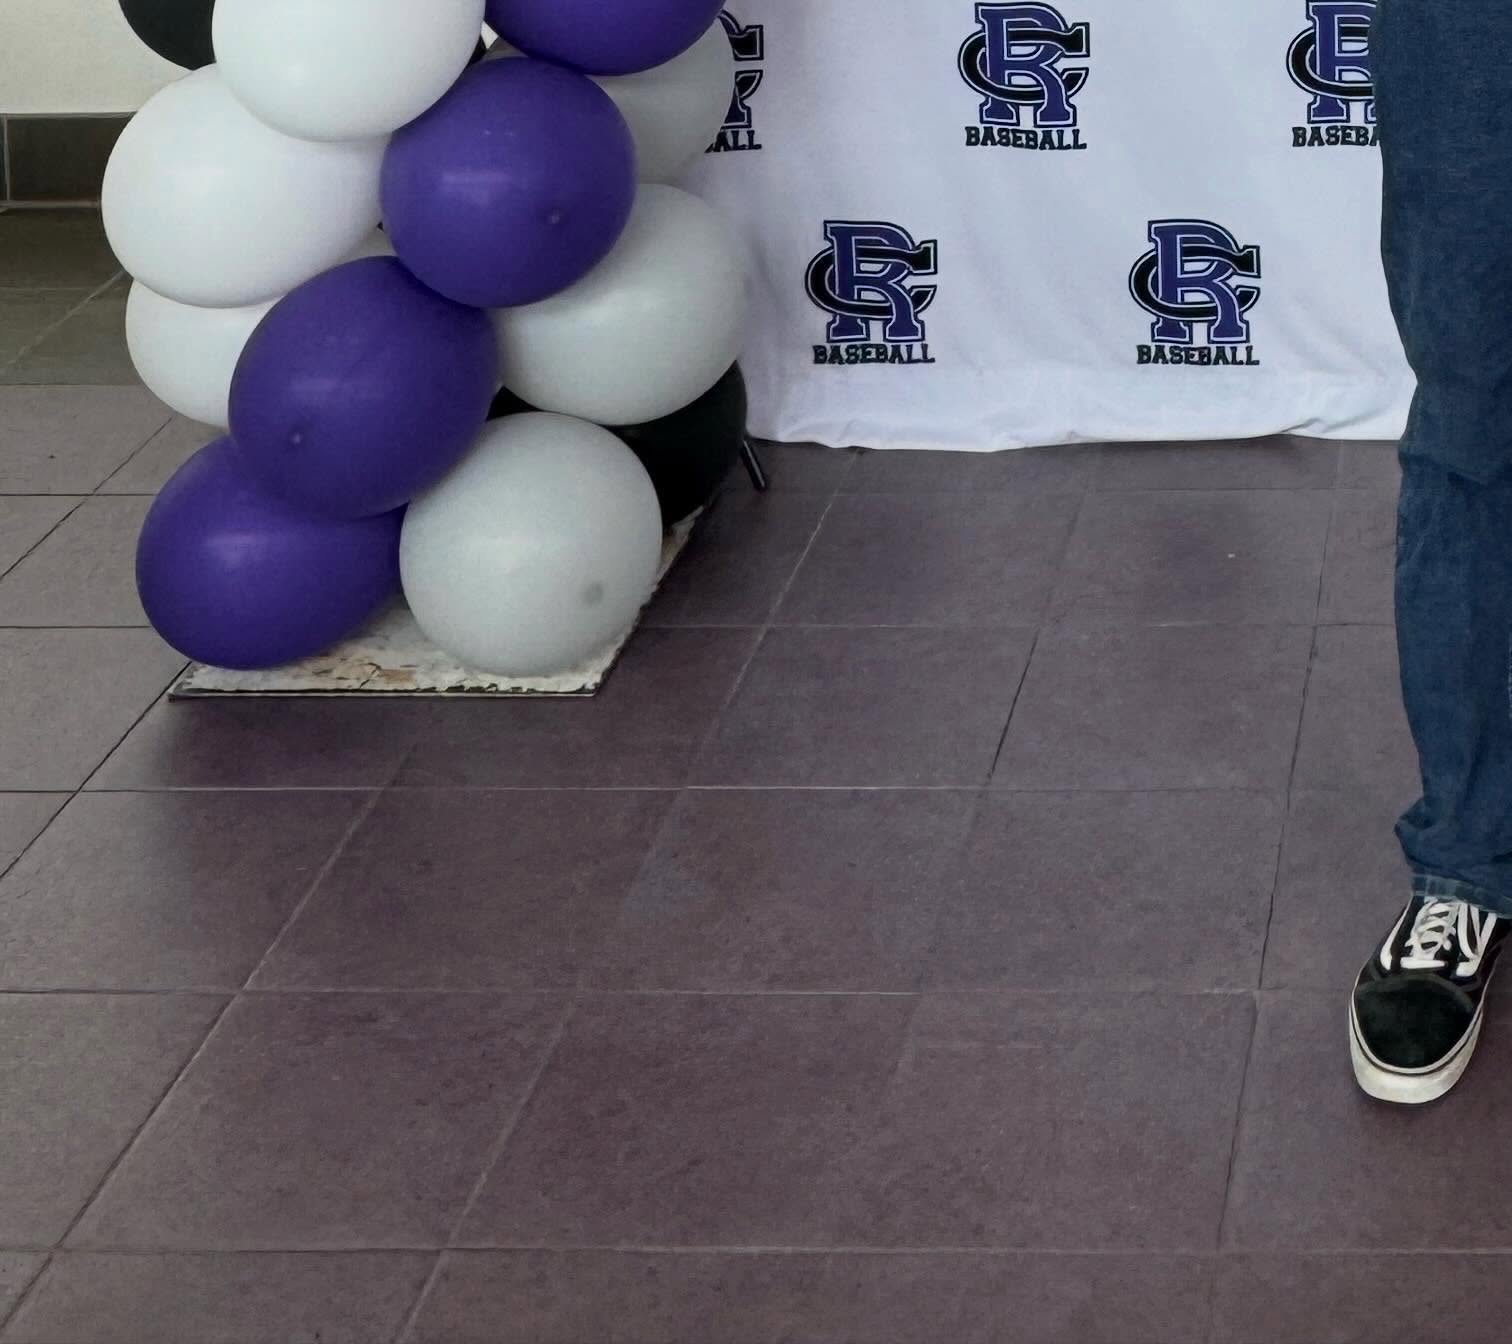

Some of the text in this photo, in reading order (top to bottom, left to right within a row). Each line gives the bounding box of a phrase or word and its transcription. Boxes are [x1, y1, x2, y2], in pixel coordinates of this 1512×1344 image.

[966, 127, 1087, 150] BASEBALL
[813, 344, 936, 365] BASEBALL
[1137, 345, 1260, 366] BASEBALL
